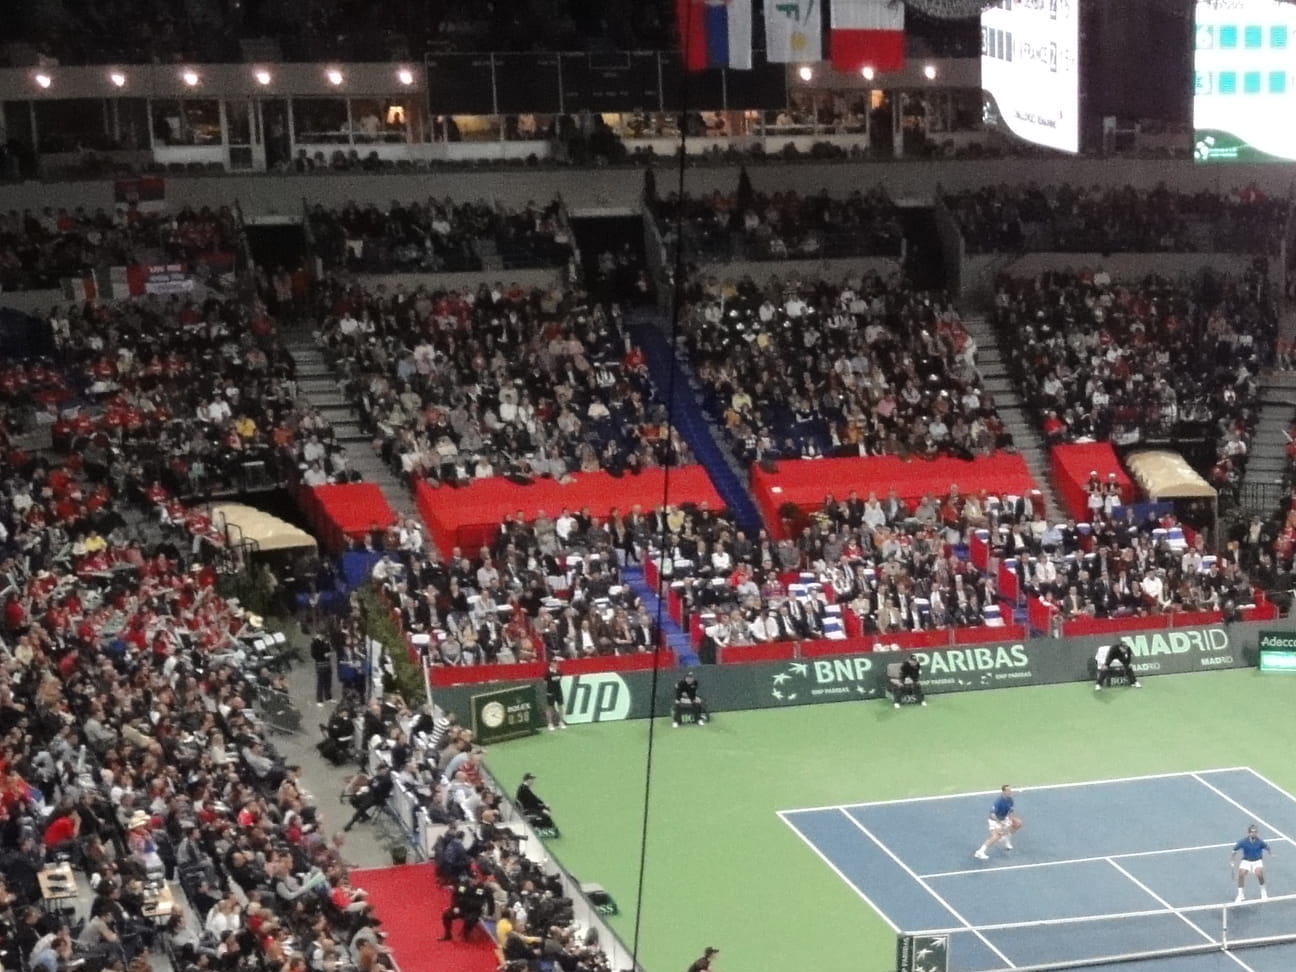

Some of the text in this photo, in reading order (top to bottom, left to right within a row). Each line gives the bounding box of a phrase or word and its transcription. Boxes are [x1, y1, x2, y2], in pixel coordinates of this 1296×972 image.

[1121, 629, 1229, 657] MADRID
[813, 657, 872, 684] BNP
[912, 644, 1029, 674] PARIBAS
